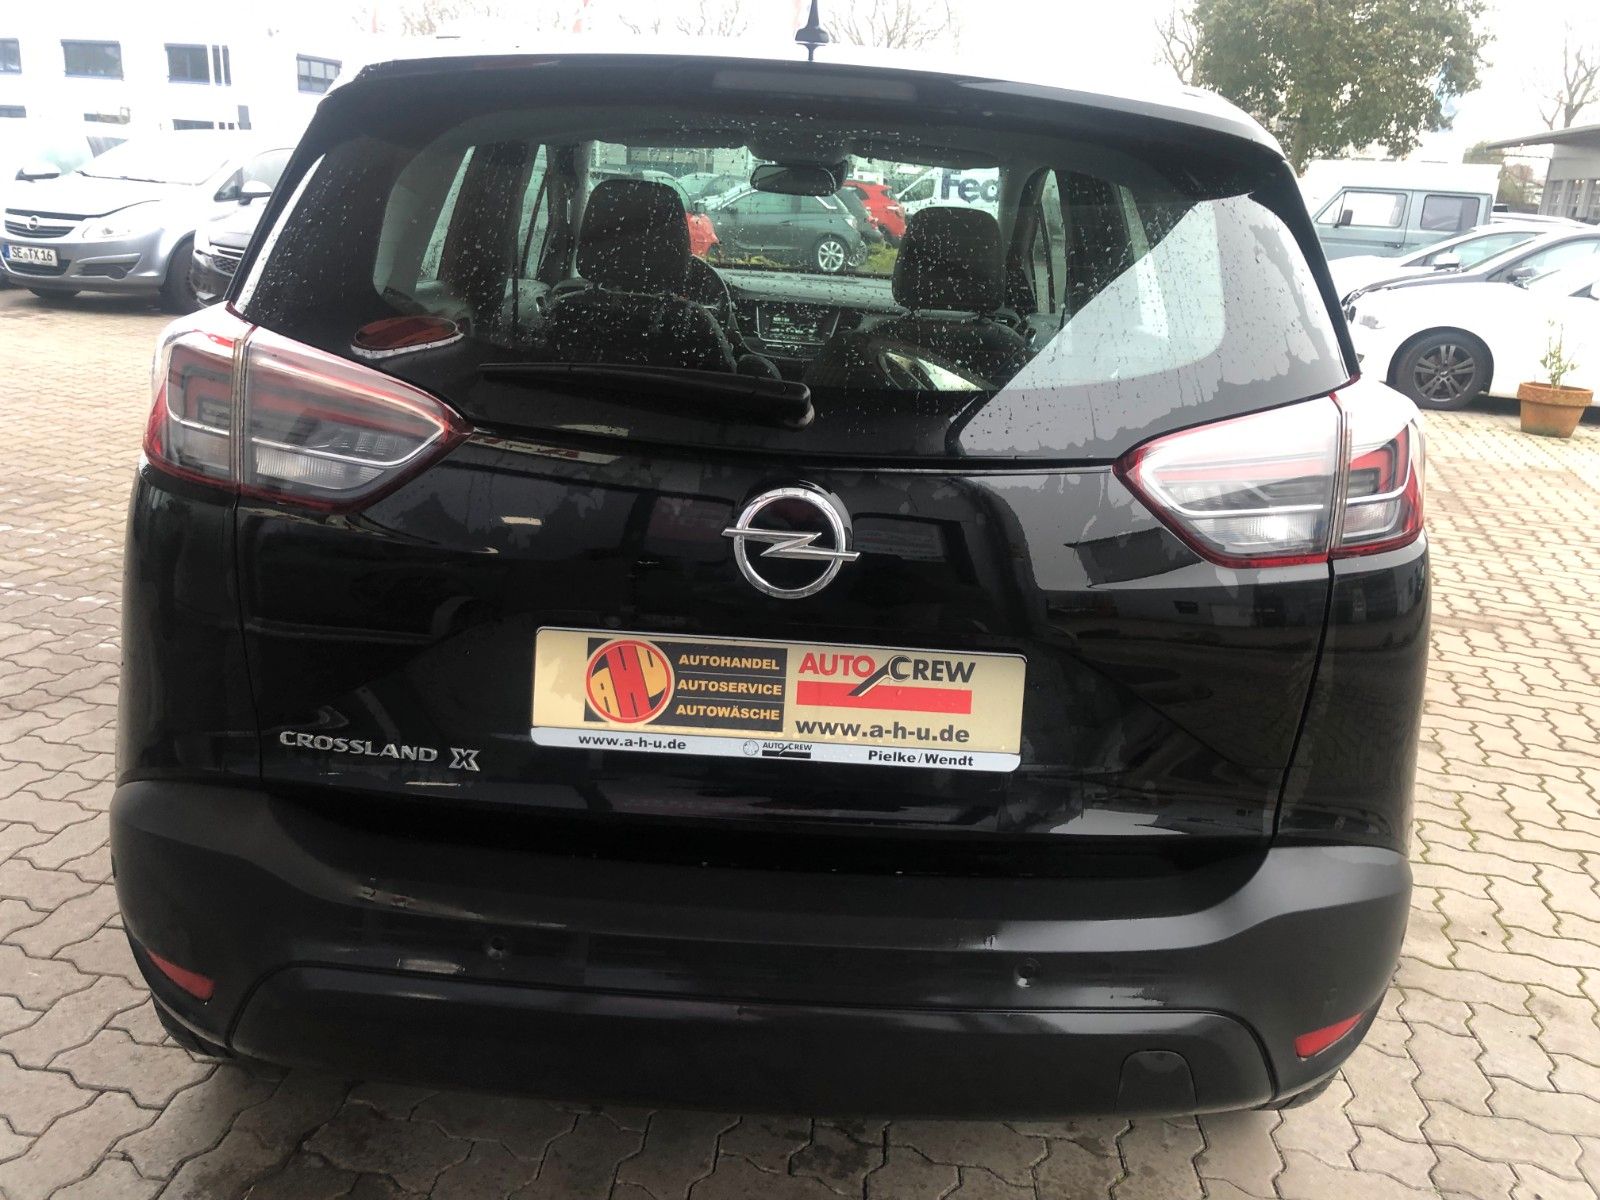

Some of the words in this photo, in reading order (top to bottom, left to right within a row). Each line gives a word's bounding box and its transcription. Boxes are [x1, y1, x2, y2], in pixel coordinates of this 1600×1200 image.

[12, 246, 23, 259] SE
[679, 654, 780, 670] AUTOHANDEL
[799, 652, 876, 678] AUTO
[890, 656, 976, 683] CREW
[677, 679, 783, 696] AUTOSERVICE
[676, 704, 780, 720] AUTOWÄSCHE
[795, 720, 970, 742] www.a-h-u.de
[578, 735, 687, 750] www.a-h-u.de
[279, 731, 438, 762] CROSSLAND
[448, 748, 481, 772] X
